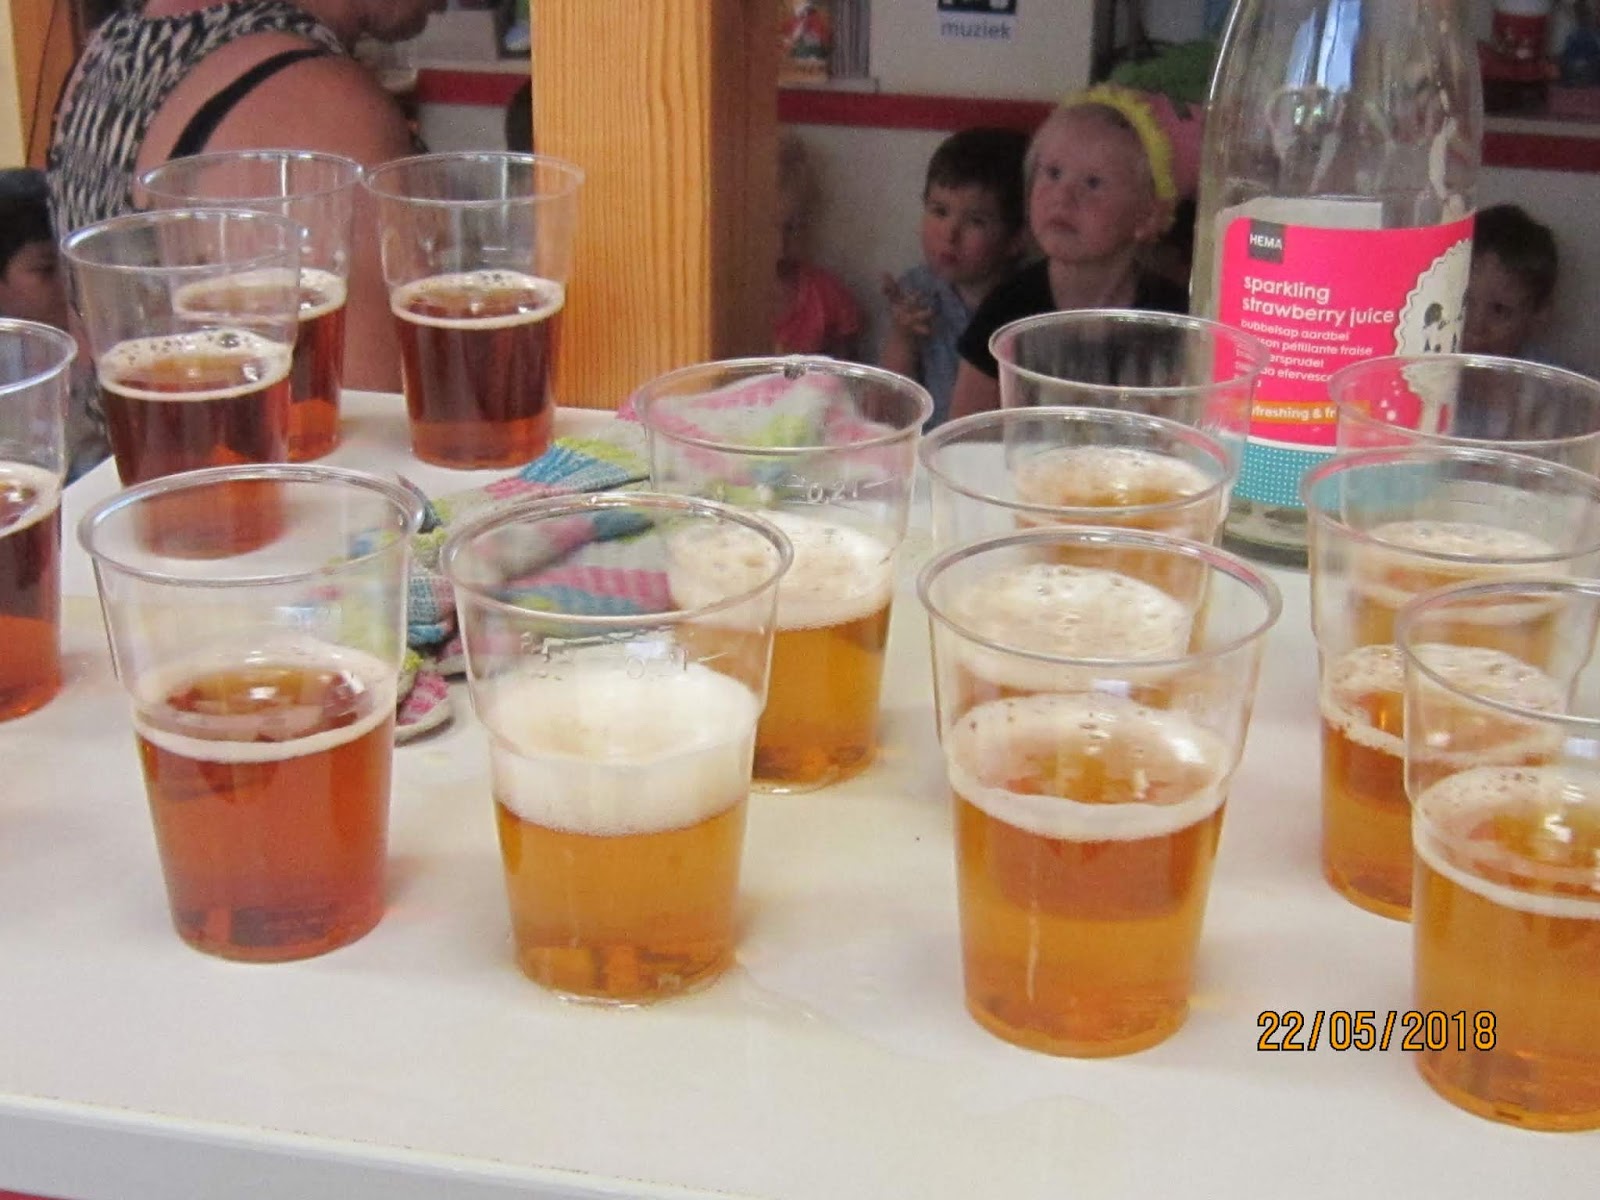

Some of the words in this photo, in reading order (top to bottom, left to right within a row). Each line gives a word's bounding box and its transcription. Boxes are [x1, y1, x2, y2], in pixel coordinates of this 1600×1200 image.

[941, 22, 1012, 39] muziek
[1250, 234, 1283, 250] HEMA
[1243, 276, 1331, 305] sparkling
[1242, 297, 1346, 327] strawberry
[1350, 307, 1395, 328] juice
[1240, 319, 1299, 339] bubbelsap
[1301, 330, 1350, 342] aardbei
[1340, 344, 1373, 356] fraise
[1312, 407, 1322, 419] &
